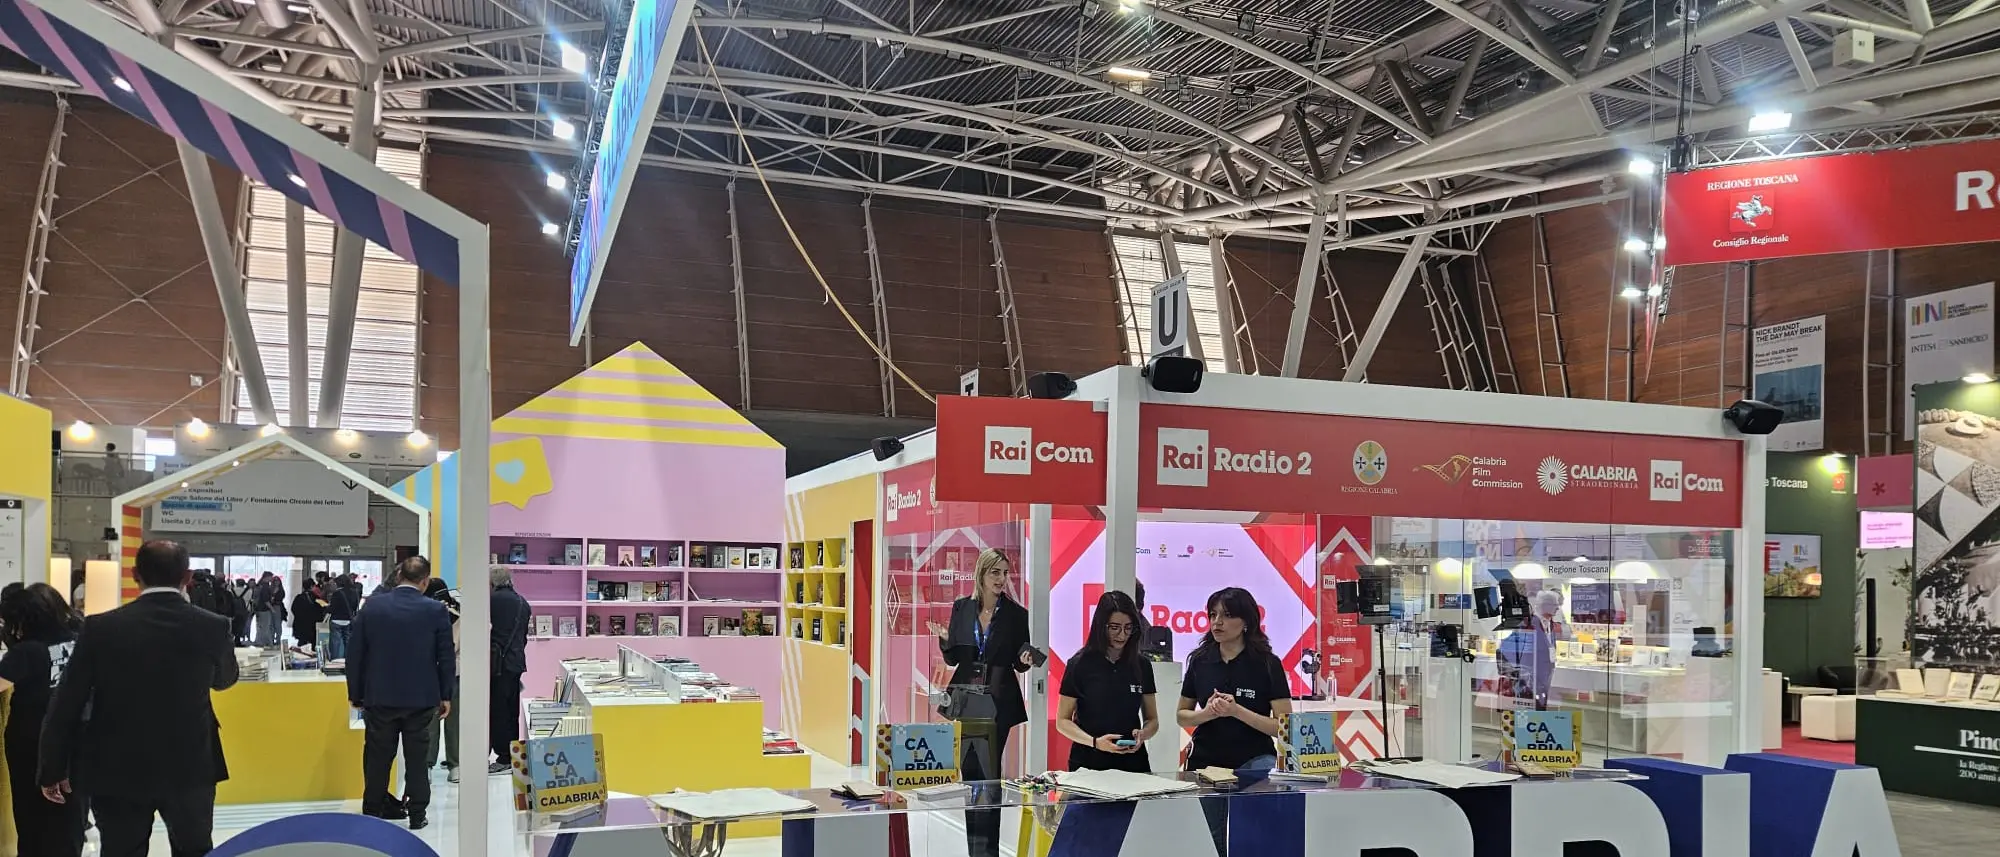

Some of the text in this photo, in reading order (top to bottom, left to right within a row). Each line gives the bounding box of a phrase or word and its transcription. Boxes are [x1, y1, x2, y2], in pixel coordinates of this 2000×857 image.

[1707, 174, 1799, 191] REGIONE TOSCANA
[1956, 170, 2000, 211] R
[1713, 234, 1789, 248] Consiglio Regionale
[1159, 290, 1178, 346] U
[1755, 322, 1801, 337] NICK BRANDT
[1756, 335, 1768, 343] THE
[1770, 332, 1783, 340] DAY
[1783, 330, 1799, 338] MAY
[1799, 324, 1823, 335] BREAK
[989, 440, 1094, 463] Rai Com
[1162, 444, 1312, 475] Rai Radio 2
[1472, 457, 1507, 466] Calabria
[1472, 467, 1491, 477] Film
[1570, 464, 1638, 482] CALABRIA
[1472, 479, 1523, 489] Commission
[1570, 481, 1638, 489] STRAORDINARIA
[1653, 472, 1724, 492] Rai Com
[1771, 476, 1808, 489] Toscana
[1368, 487, 1398, 495] CALABRIA
[898, 491, 917, 510] Radio
[916, 489, 922, 506] 2
[1548, 565, 1609, 575] Regione Toscana
[1300, 724, 1316, 736] CA
[1526, 722, 1549, 733] CA
[904, 737, 929, 751] CA
[544, 751, 569, 766] CA
[1301, 759, 1339, 769] CALABRIA
[1521, 754, 1573, 763] CALABRIA
[1960, 760, 2000, 772] la Regione
[896, 775, 952, 786] CALABRIA
[1960, 769, 1996, 782] 200 anni
[540, 791, 600, 807] CALABRIA
